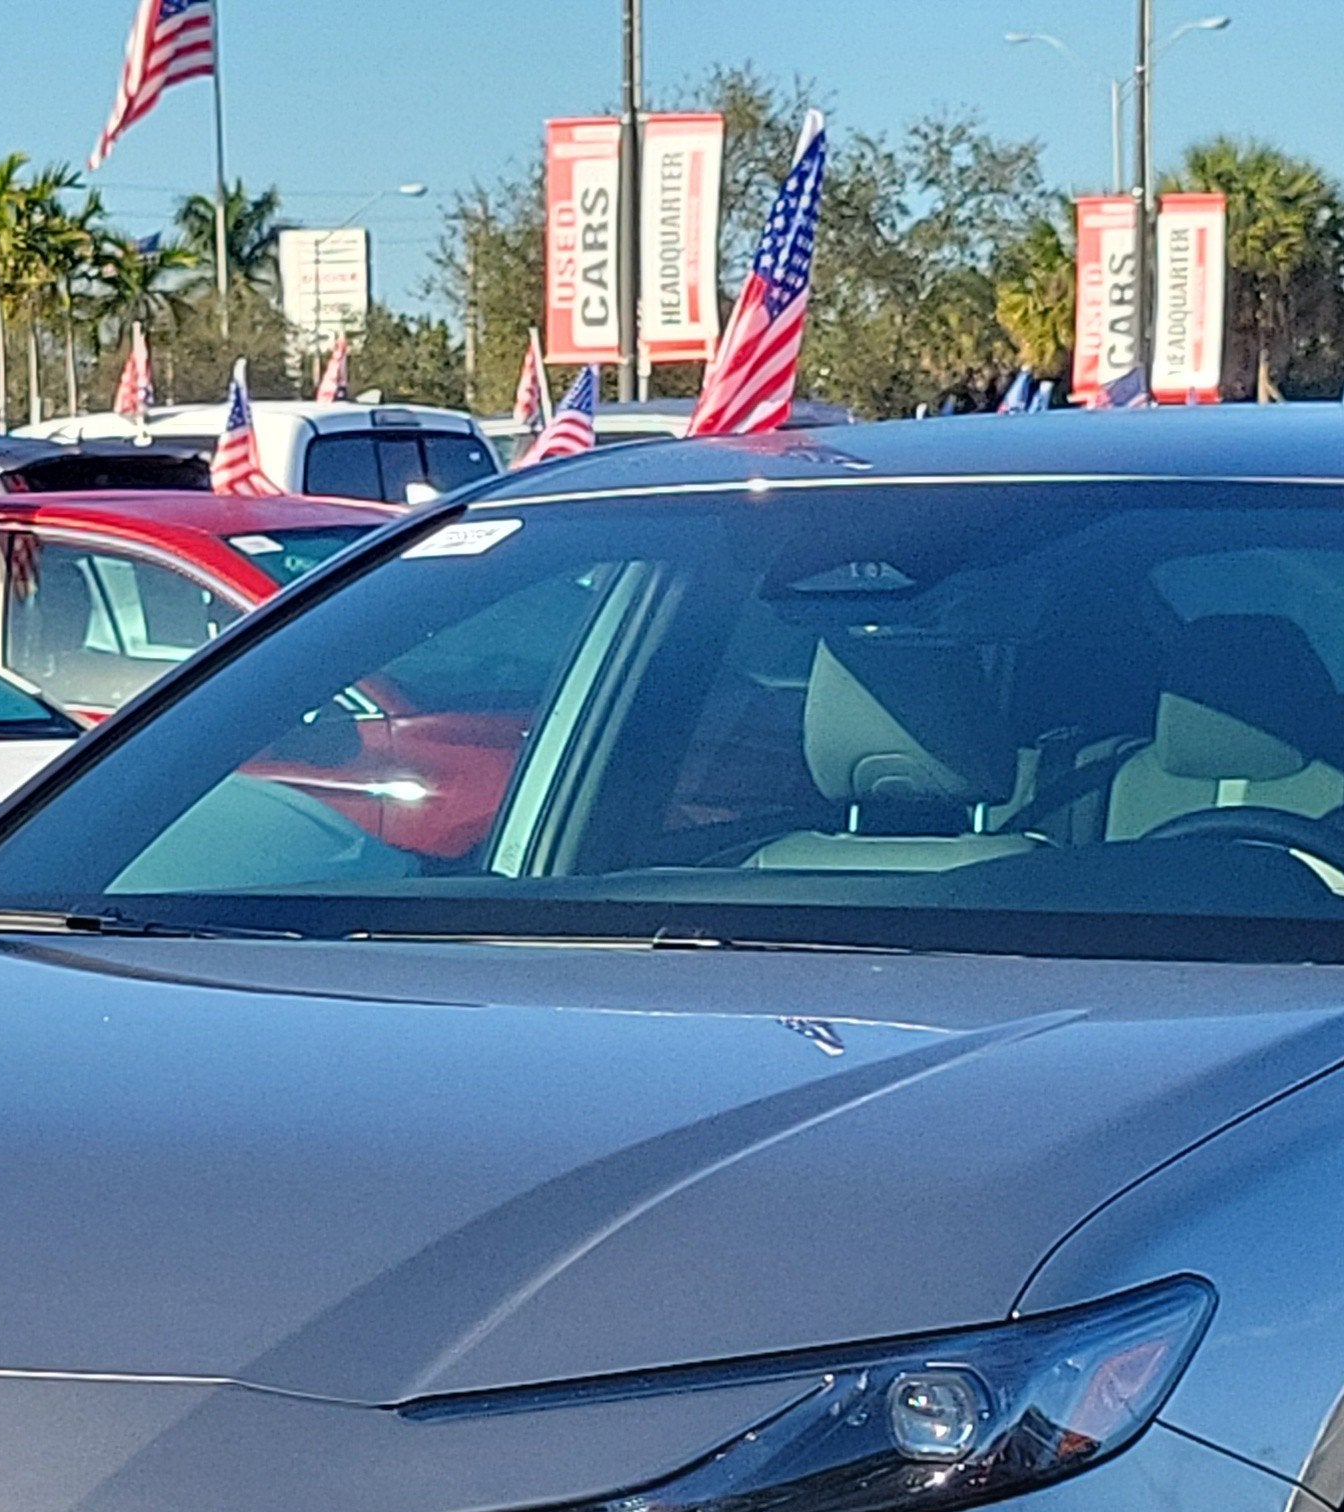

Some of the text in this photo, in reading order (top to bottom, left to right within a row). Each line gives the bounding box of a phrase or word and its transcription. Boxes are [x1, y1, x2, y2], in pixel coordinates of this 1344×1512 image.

[558, 206, 575, 303] USED
[580, 187, 610, 327] CARS
[659, 151, 685, 325] HEADQUARTER
[1107, 251, 1138, 369] CARS
